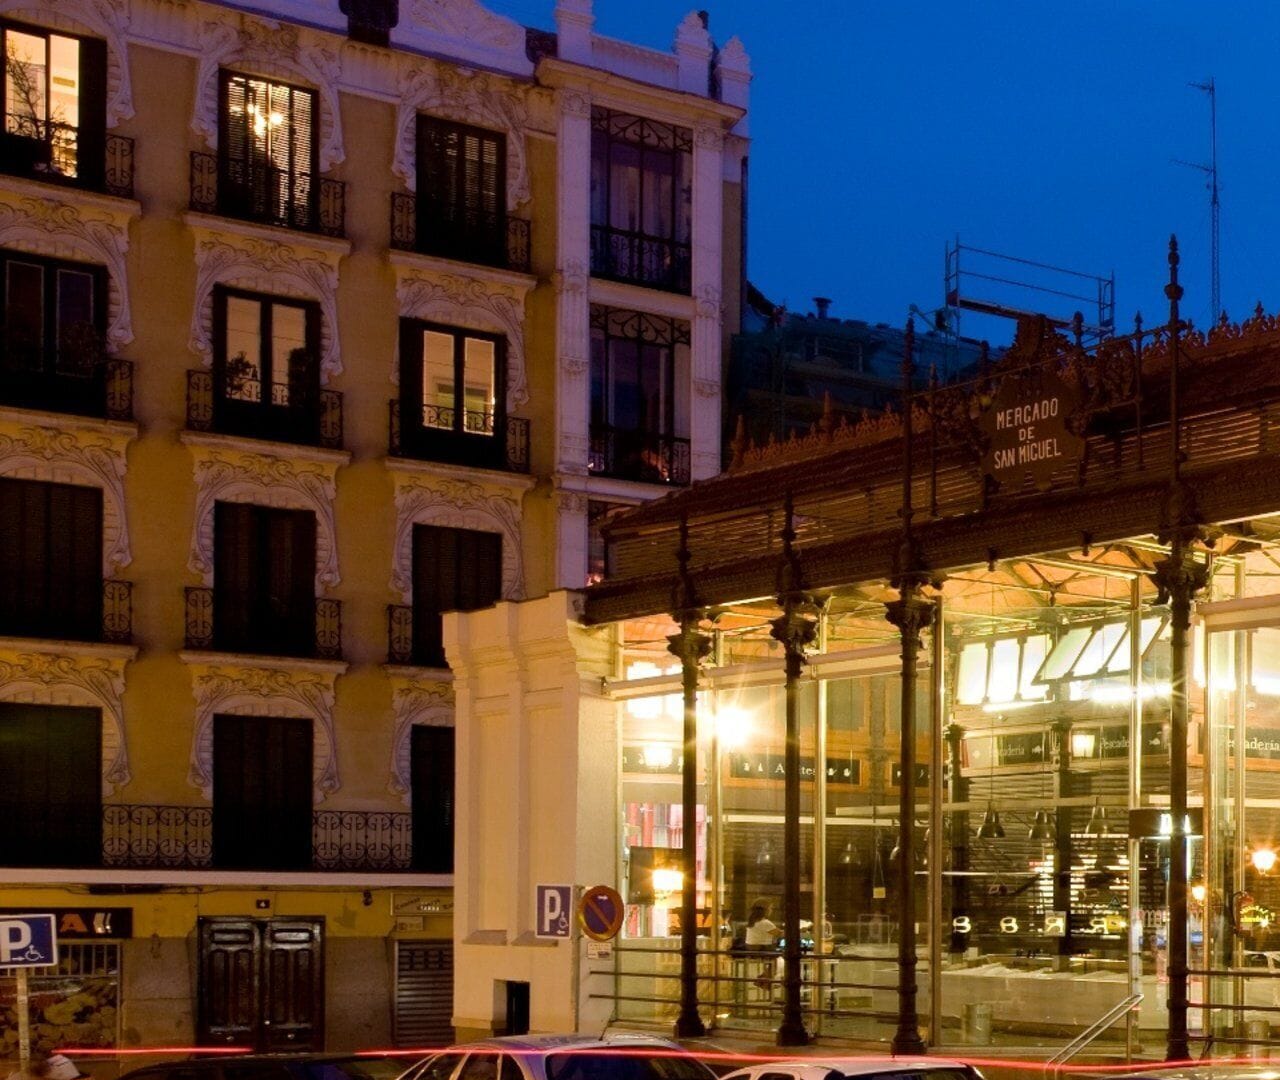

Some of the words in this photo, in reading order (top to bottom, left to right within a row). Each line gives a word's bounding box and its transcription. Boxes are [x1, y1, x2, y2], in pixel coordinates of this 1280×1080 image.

[996, 398, 1059, 430] MERCADO
[1018, 426, 1035, 441] DE
[994, 448, 1016, 469] SAN
[1018, 438, 1062, 463] MIGUEL
[543, 889, 561, 932] P
[0, 920, 32, 963] P
